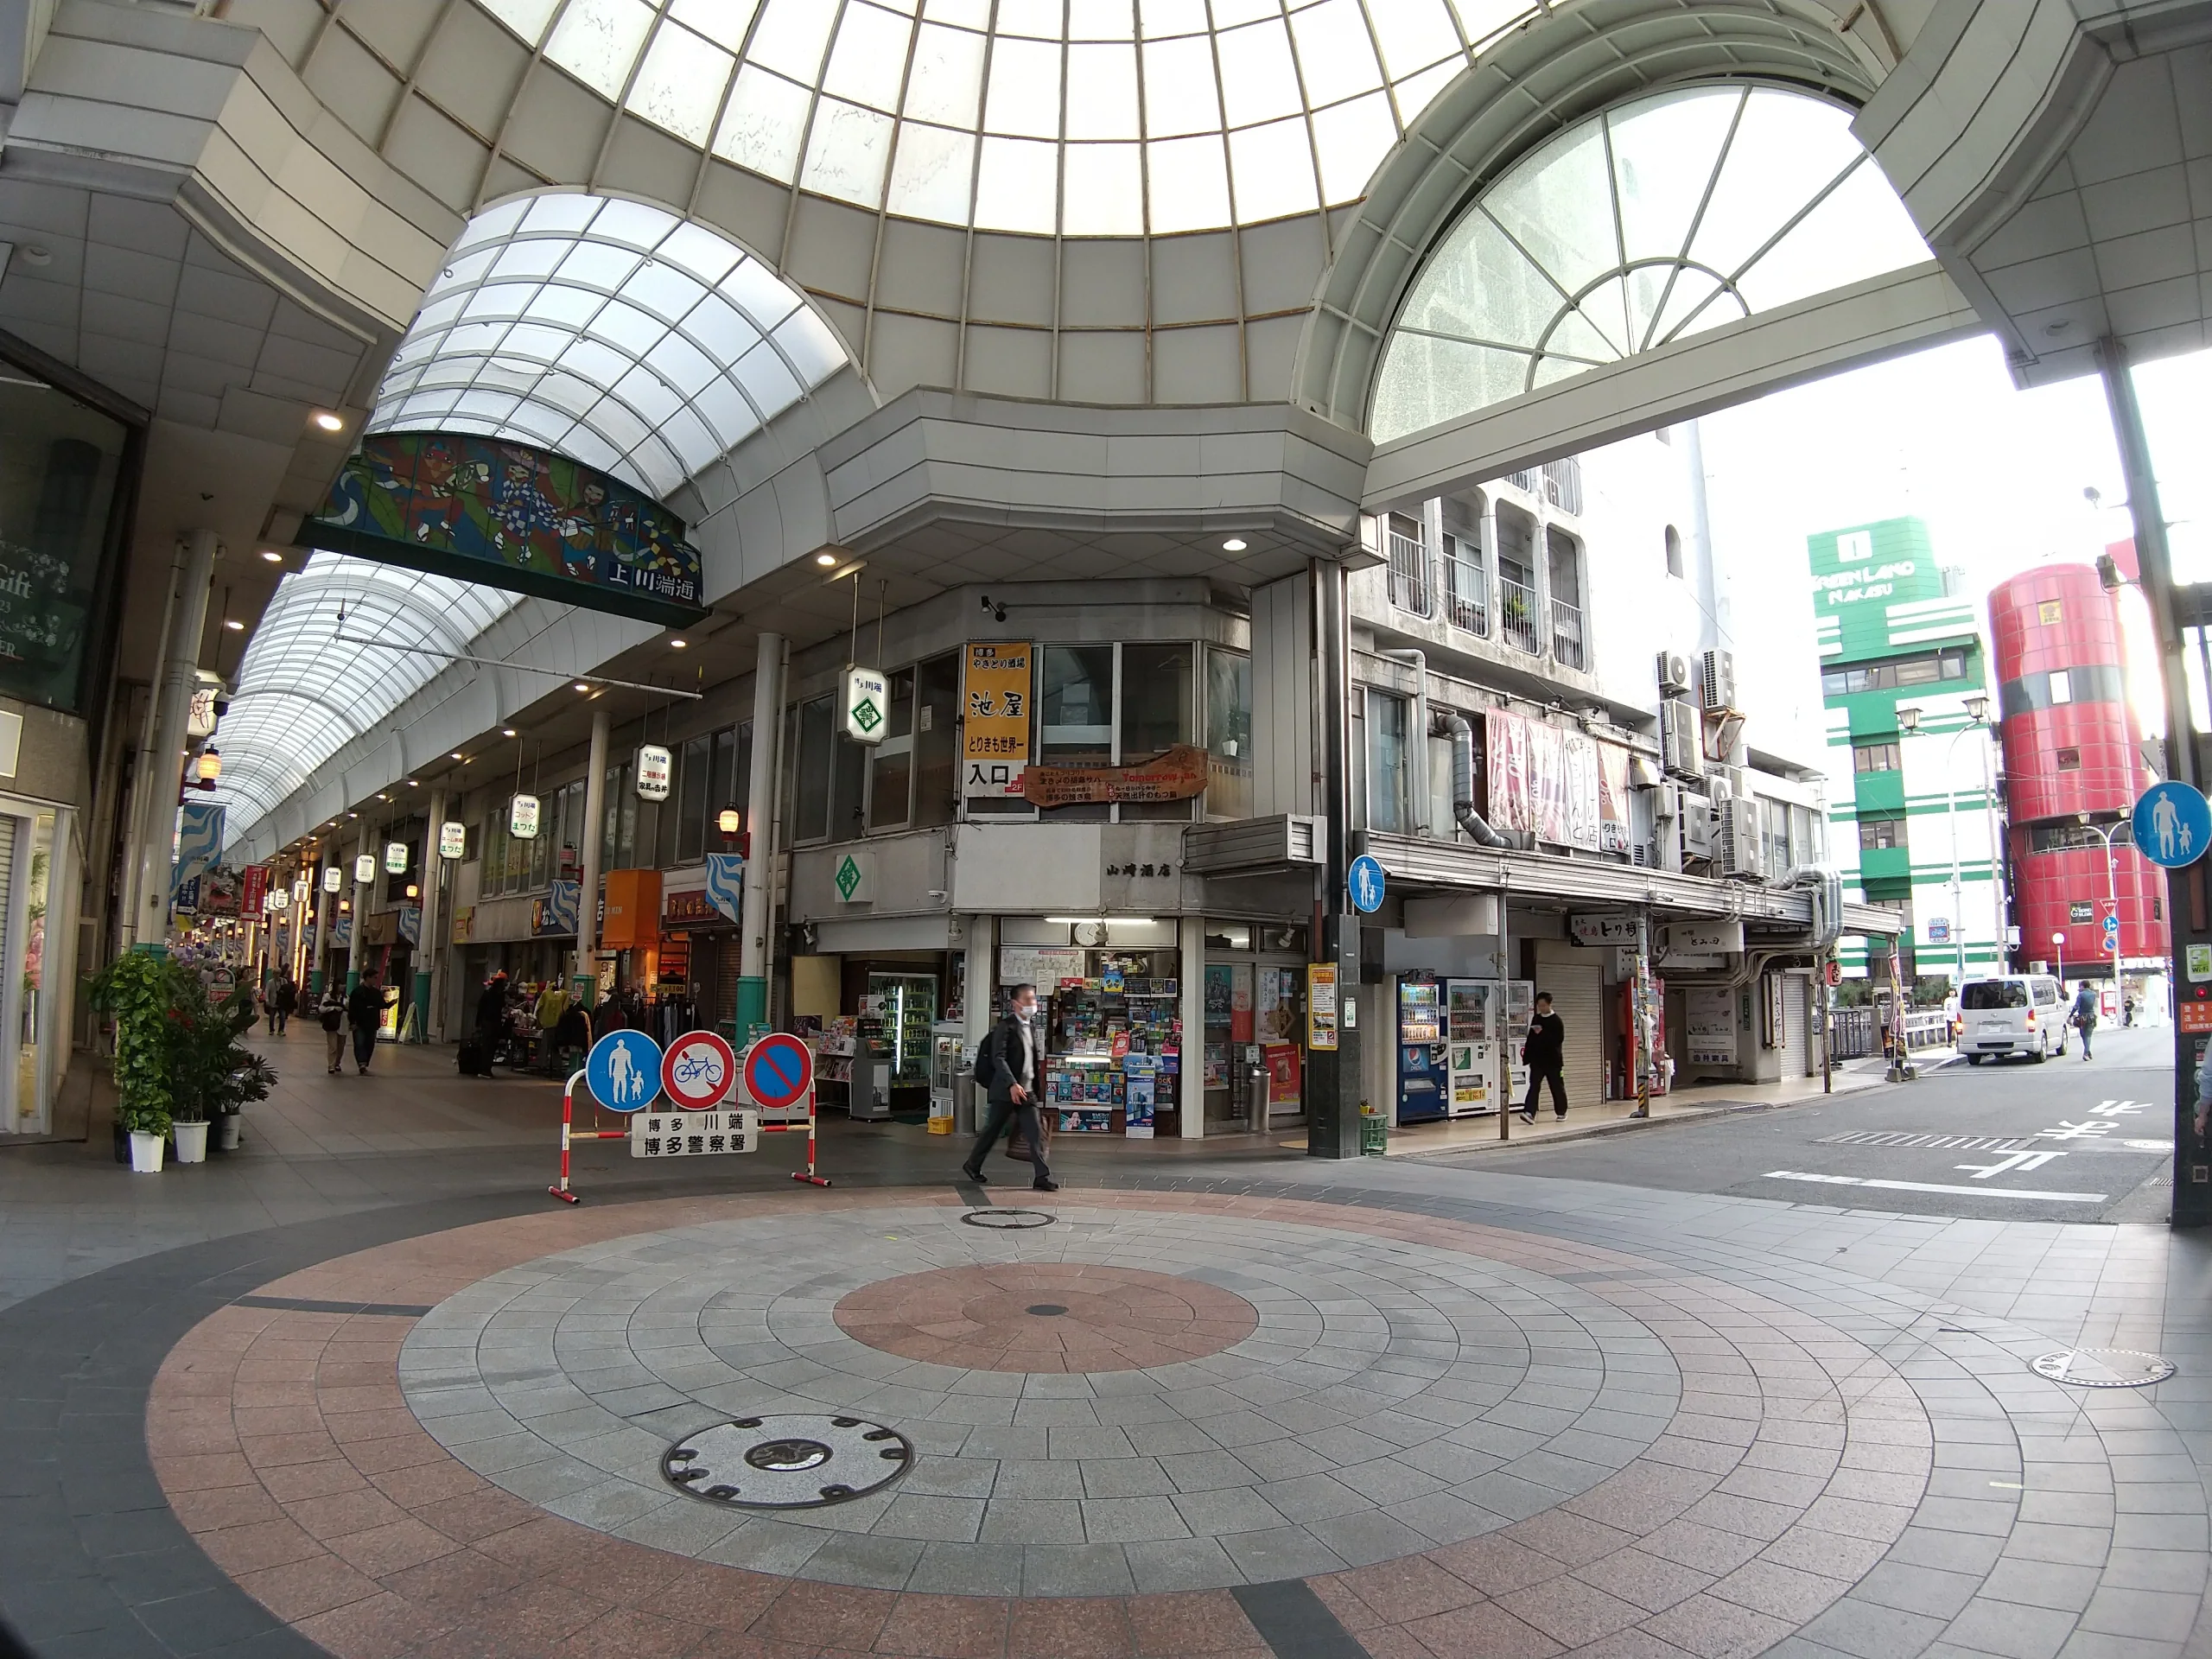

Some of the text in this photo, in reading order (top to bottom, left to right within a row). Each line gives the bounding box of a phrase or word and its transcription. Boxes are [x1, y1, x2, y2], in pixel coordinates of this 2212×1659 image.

[609, 563, 695, 601] 上川端通
[1827, 582, 1893, 605] NAKASU
[975, 648, 995, 657] 博多
[973, 658, 1026, 670] やきとり酒場
[970, 691, 1025, 717] 池屋
[969, 736, 1025, 753] とりきも世界一
[968, 764, 1009, 785] 入口
[1106, 862, 1171, 878] 山崎酒店
[648, 1113, 744, 1133] 博多 川端
[644, 1134, 746, 1156] 博多警察署
